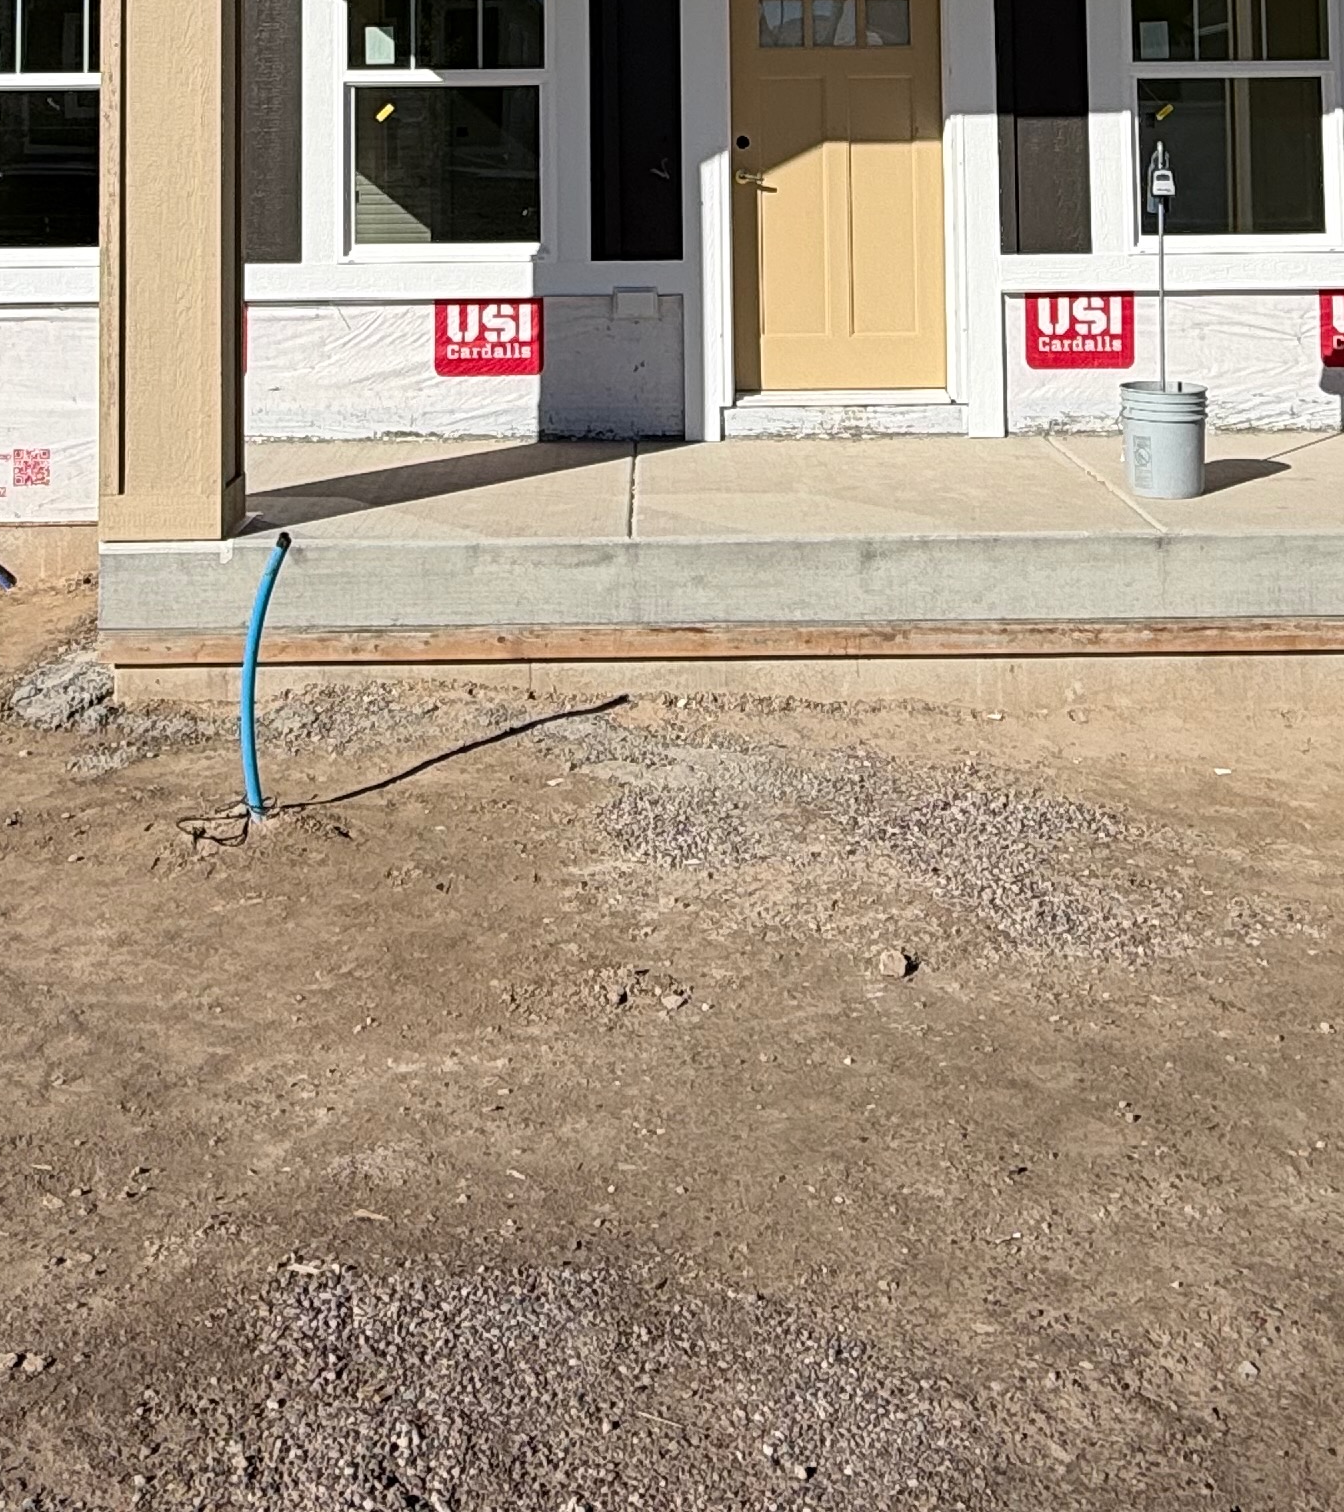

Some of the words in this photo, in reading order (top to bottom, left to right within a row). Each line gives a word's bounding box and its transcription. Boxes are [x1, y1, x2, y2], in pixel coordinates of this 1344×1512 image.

[446, 304, 532, 343] USI
[1038, 296, 1122, 336] USI
[446, 343, 532, 360] Cardalls
[1038, 336, 1122, 352] Cardalls
